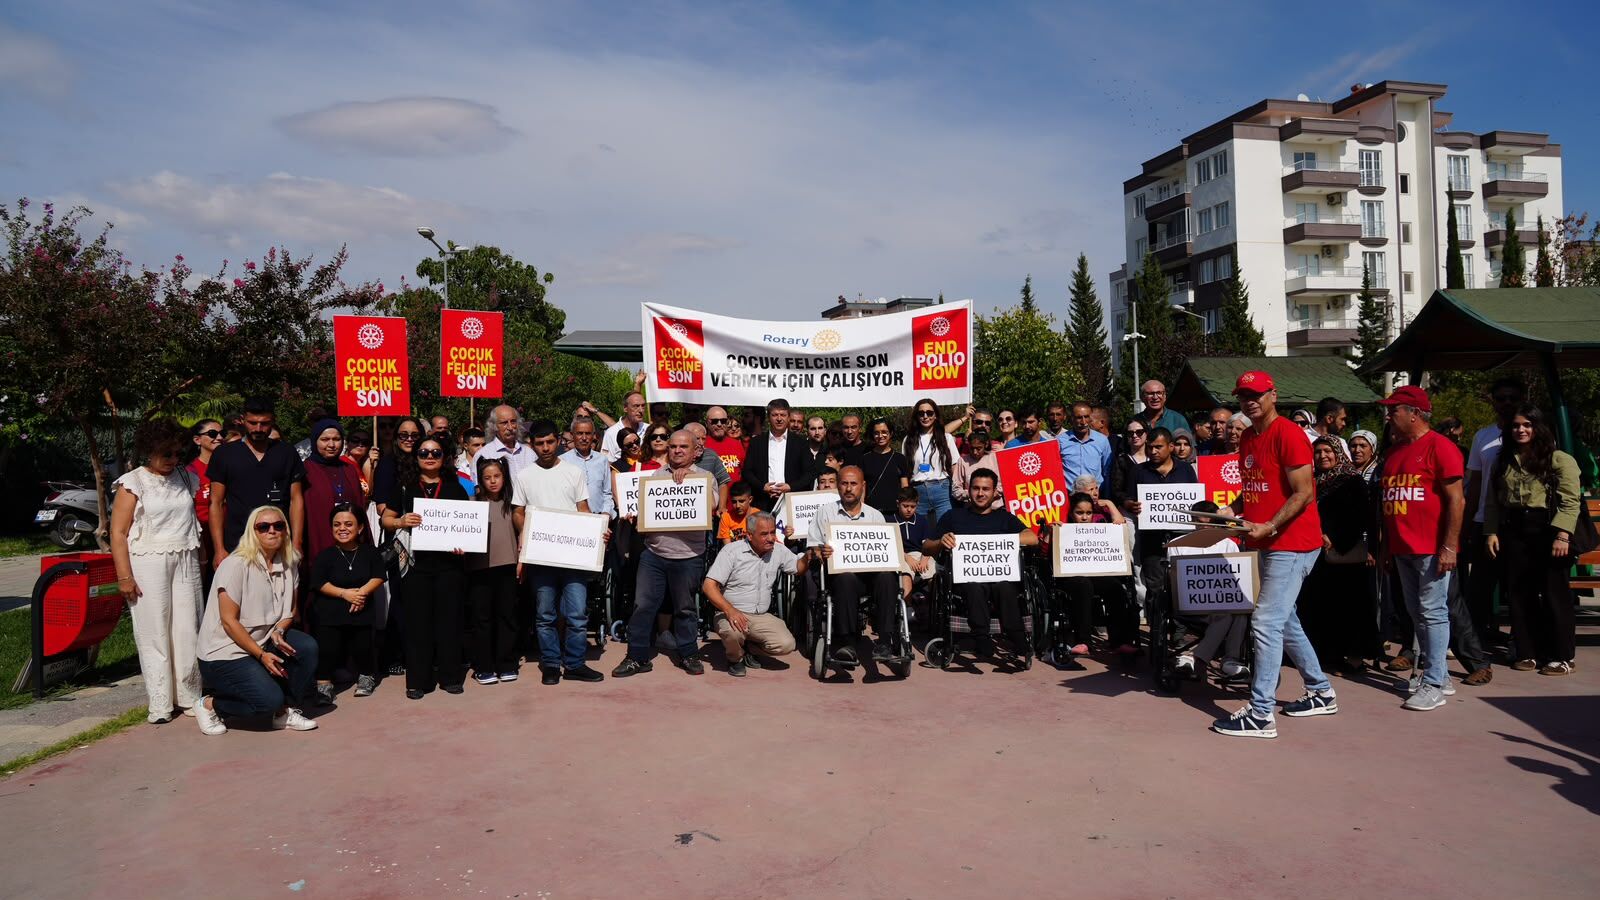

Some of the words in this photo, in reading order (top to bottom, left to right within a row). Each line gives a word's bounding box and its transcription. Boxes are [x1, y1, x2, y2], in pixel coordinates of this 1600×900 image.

[763, 334, 809, 347] Rotary
[923, 340, 958, 355] END
[449, 347, 494, 363] ÇOCUK
[915, 352, 965, 368] POLIO
[346, 358, 398, 377] ÇOCUK
[726, 354, 781, 372] ÇOCUK
[856, 353, 889, 368] SON
[668, 370, 693, 383] SON
[921, 365, 960, 380] NOW
[456, 374, 487, 390] SON
[710, 372, 778, 388] VERMEK
[820, 371, 904, 392] ÇALIŞIYOR
[356, 389, 392, 407] SON
[647, 485, 704, 496] ACARKENT
[1015, 478, 1055, 500] END
[1145, 491, 1197, 500] BEYOĞLU
[655, 498, 697, 508] ROTARY
[1008, 490, 1066, 516] POLIO
[1213, 490, 1242, 507] EN
[1242, 492, 1260, 503] ON
[1150, 503, 1193, 511] ROTARY
[1382, 501, 1408, 515] ON
[423, 509, 451, 518] Kültür
[453, 510, 479, 519] Sanat
[654, 508, 697, 520] KULÜBÜ
[1016, 505, 1061, 529] NOW
[418, 523, 448, 534] Rotary
[450, 524, 482, 533] Kulübü
[836, 530, 891, 540] İSTANBUL
[1075, 525, 1107, 534] İstanbul
[531, 531, 556, 543] BOSTANCI
[556, 535, 577, 546] ROTARY
[576, 537, 597, 548] KULÜBÜ
[957, 539, 1015, 553] ATAŞEHİR
[1073, 539, 1109, 547] Barbaros
[844, 542, 889, 552] ROTARY
[842, 552, 889, 564] KULÜBÜ
[963, 553, 1010, 563] ROTARY
[963, 565, 1012, 577] KULÜBÜ
[1185, 563, 1241, 575] FINDIKLI
[1187, 578, 1241, 589] ROTARY
[1189, 591, 1244, 604] KULÜBÜ
